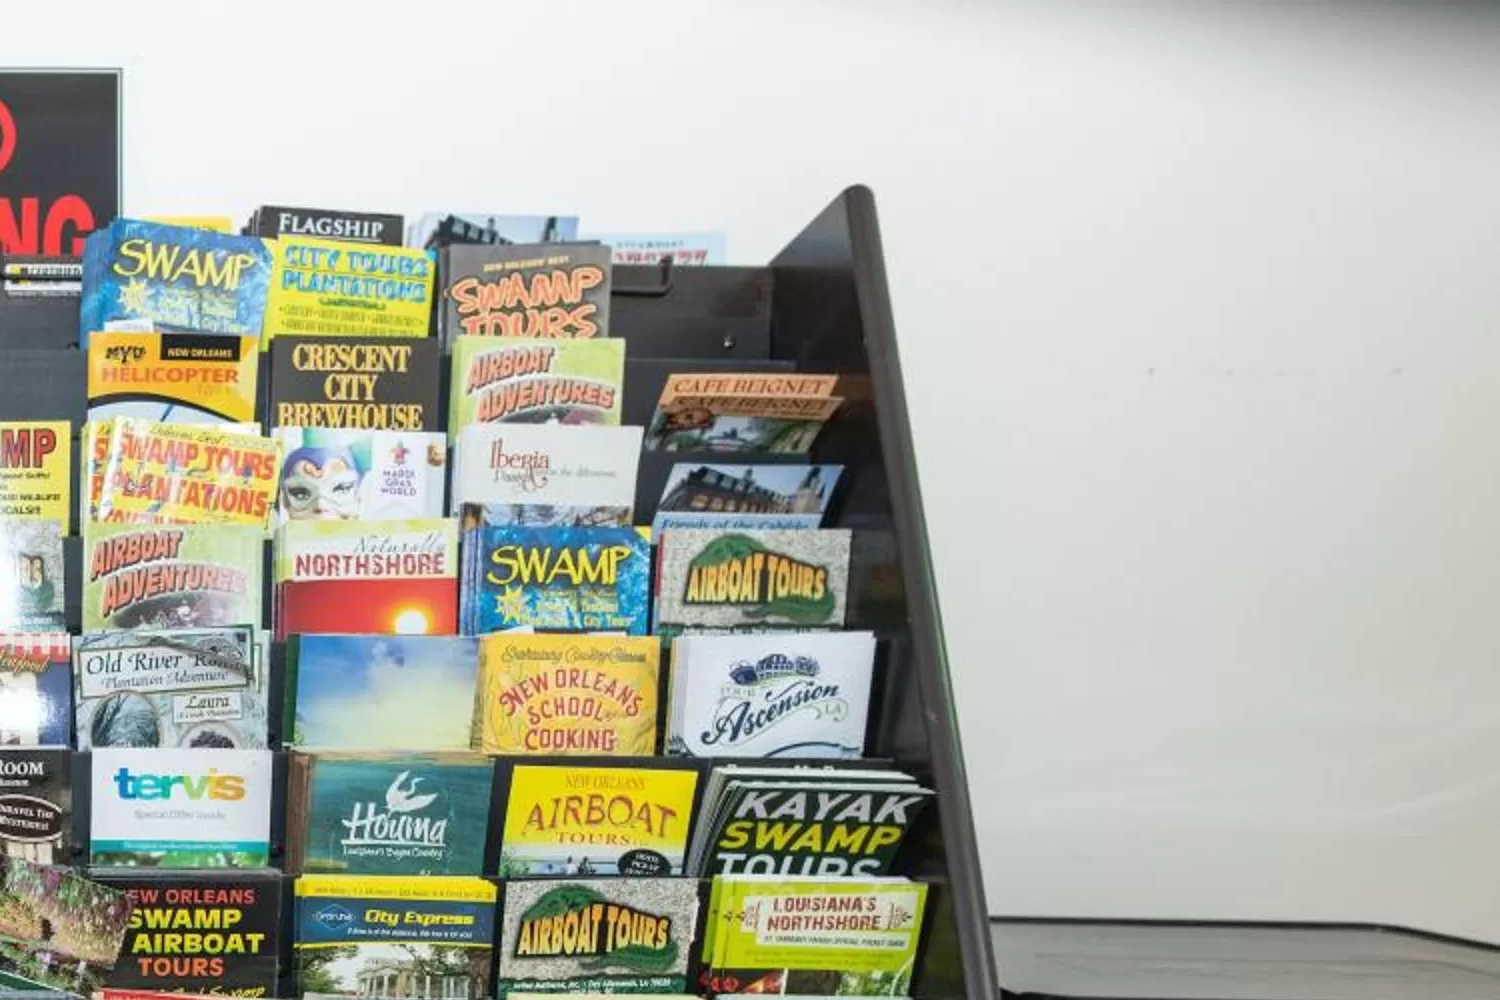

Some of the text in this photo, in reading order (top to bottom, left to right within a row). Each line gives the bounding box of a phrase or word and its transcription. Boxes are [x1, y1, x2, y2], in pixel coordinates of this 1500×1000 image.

[279, 212, 384, 239] FLAGSHIP
[114, 239, 255, 290] SWAMP
[450, 267, 604, 317] SWAMP
[292, 345, 413, 373] CRESCENT
[468, 346, 556, 393] AIRBOAT
[101, 367, 239, 384] HELICOPTER
[323, 373, 378, 401] CITY
[736, 379, 826, 395] BEIGNET
[477, 381, 617, 423] ADVENTURES
[278, 403, 423, 432] BREWHOUSE
[295, 553, 446, 577] NORTHSHORE
[486, 545, 632, 586] SWAMP
[686, 553, 825, 601] AIRBOAT TOURS
[499, 668, 644, 717] NEW ORLEANS
[527, 694, 605, 726] SCHOOL
[699, 681, 842, 746] Ascension
[524, 728, 617, 752] COOKING
[113, 767, 246, 801] tervis
[734, 791, 927, 824] KAYAK
[341, 800, 449, 845] Houma
[129, 908, 242, 929] SWAMP
[363, 908, 477, 927] City Express
[772, 896, 877, 913] LOUISIANA'S
[767, 914, 882, 932] NORTHSHORE
[132, 933, 265, 954] AIRBOAT
[138, 957, 224, 977] TOURS
